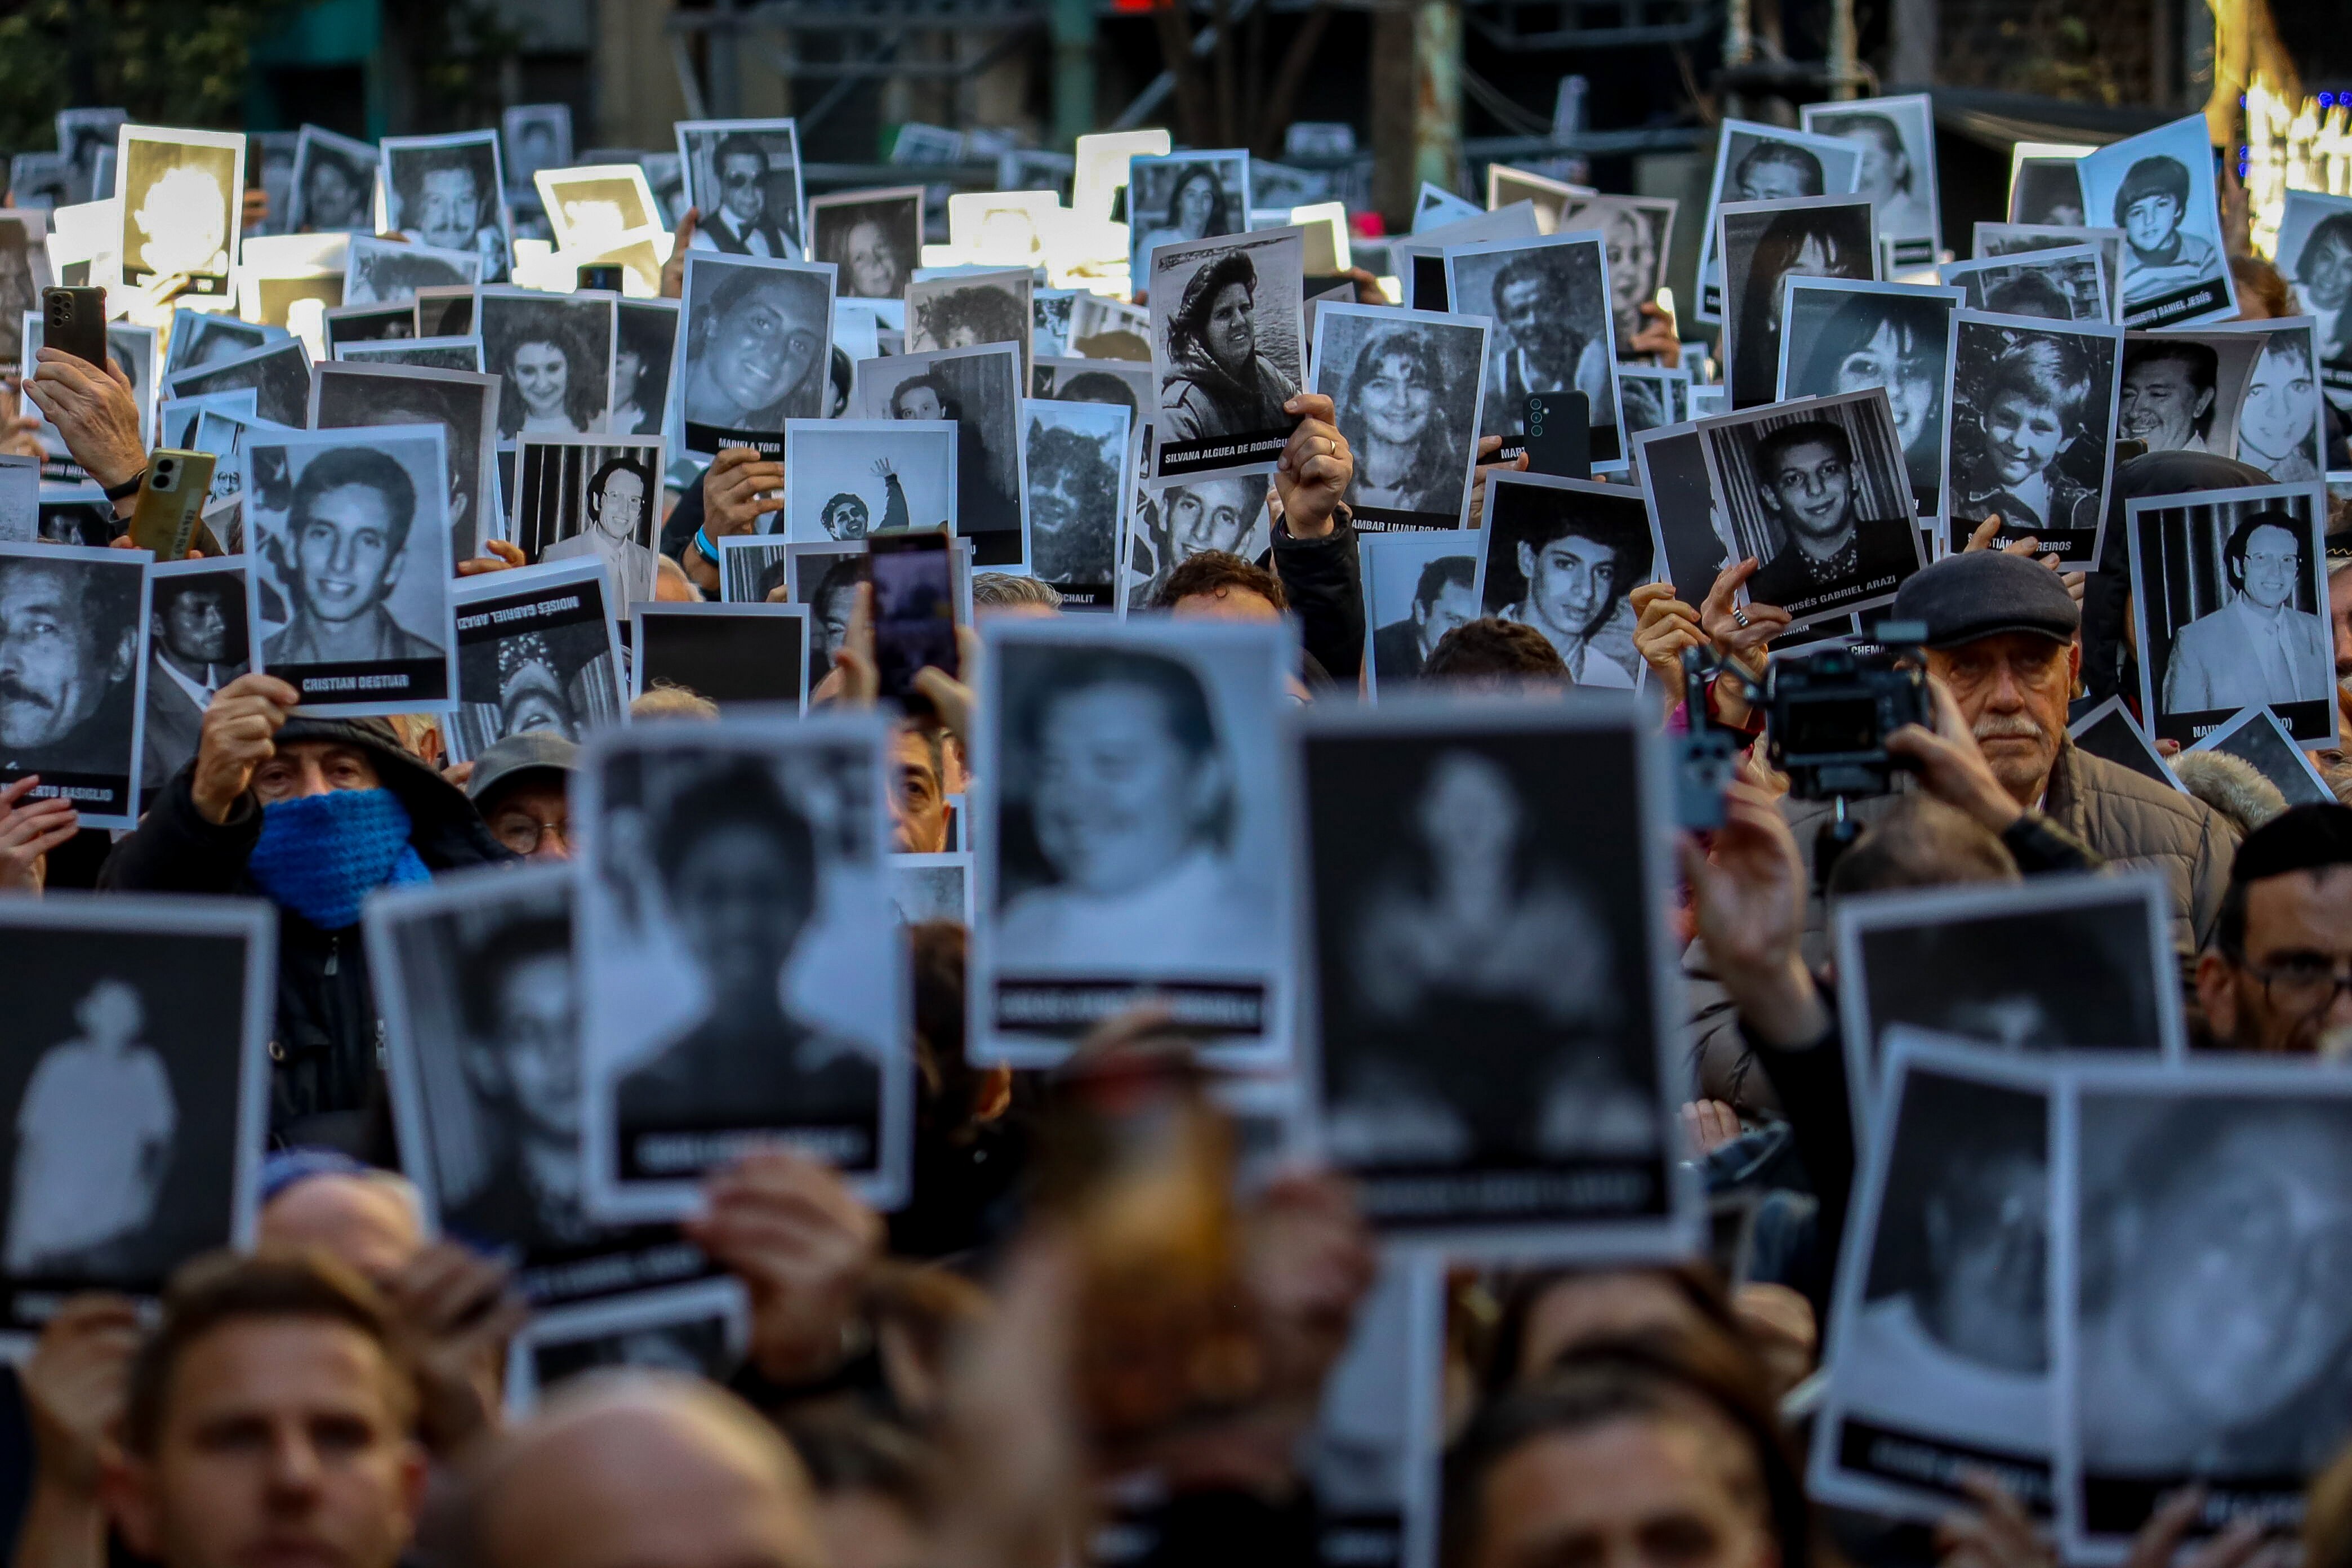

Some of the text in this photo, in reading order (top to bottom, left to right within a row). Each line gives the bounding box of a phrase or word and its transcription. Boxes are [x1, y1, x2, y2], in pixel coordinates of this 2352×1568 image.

[2158, 300, 2186, 318] DANIEL
[2186, 291, 2213, 306] JESÚS
[758, 442, 780, 453] TOER
[1165, 438, 1288, 463] SILVANA ALGUEA DE RODRÍGU
[1352, 519, 1385, 532] AMBAR
[1819, 585, 1864, 604] GABRIEL
[1866, 574, 1896, 591] ARAZI
[457, 596, 580, 630] MOISÉS GABRIEL ARAZI
[1851, 645, 1887, 656] CHEMA
[302, 677, 357, 692] CRISTIAN
